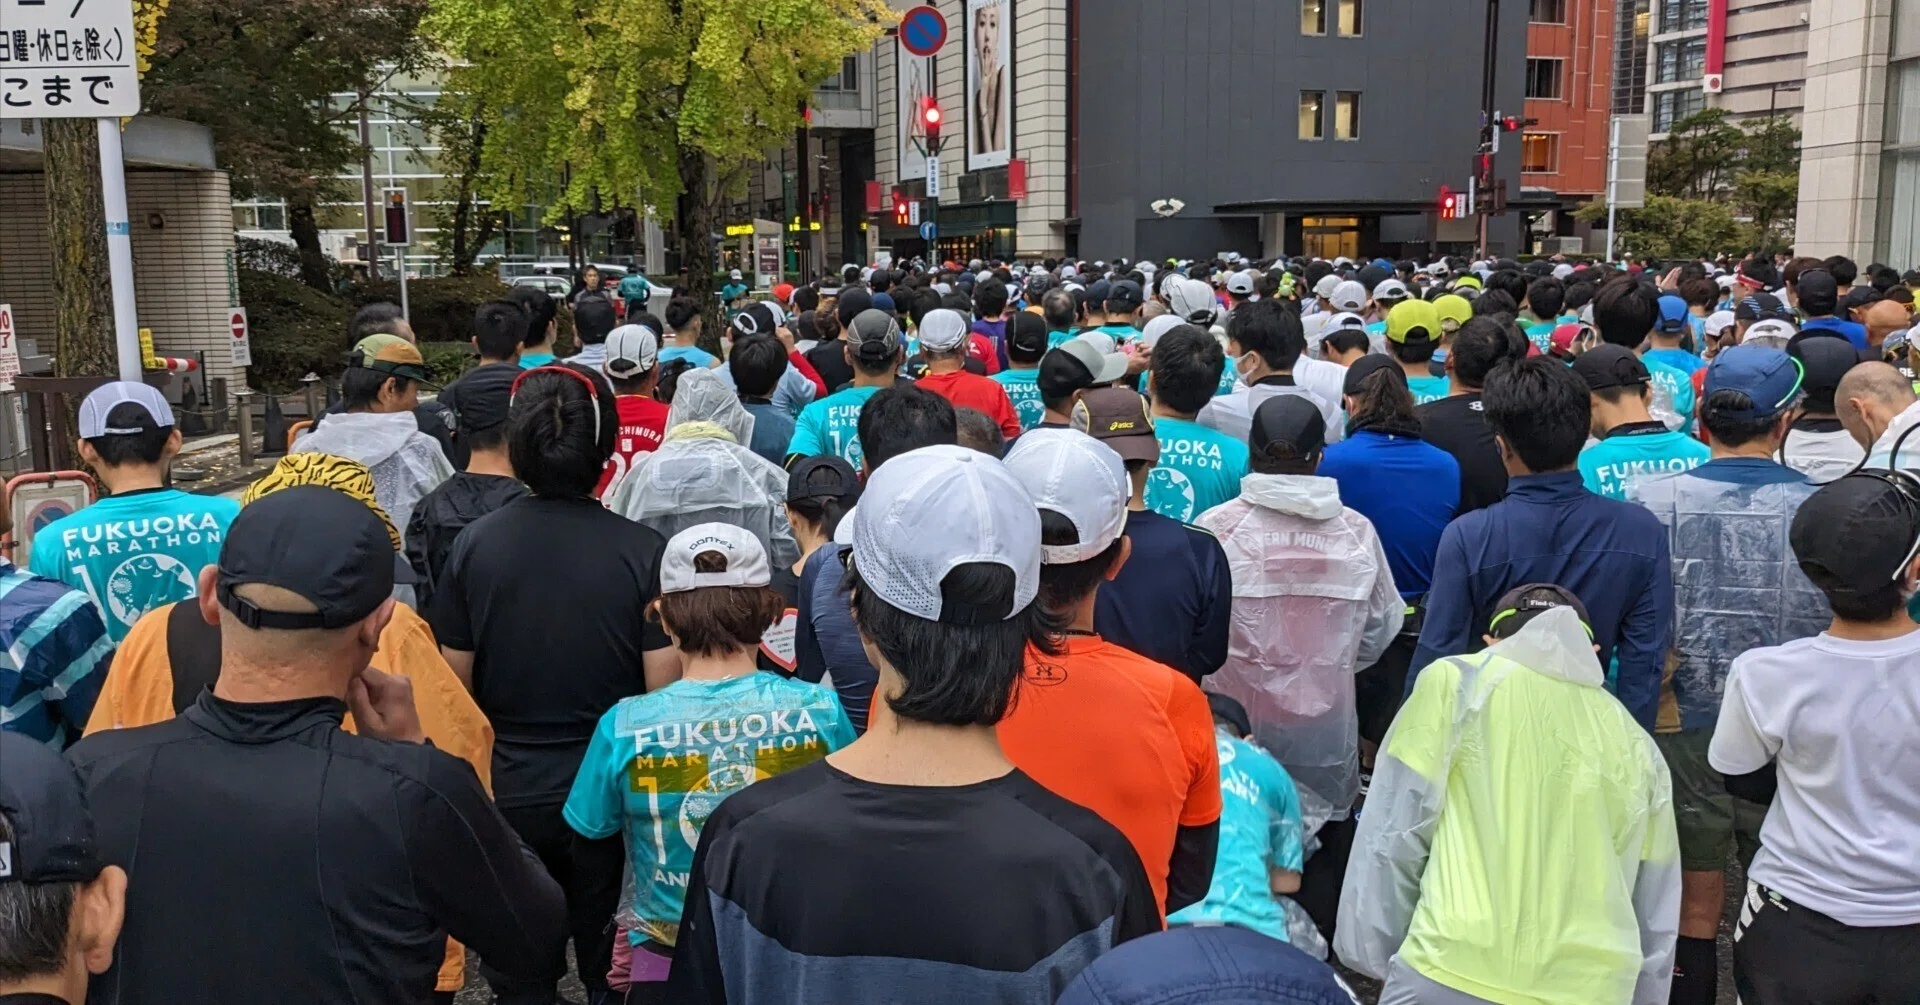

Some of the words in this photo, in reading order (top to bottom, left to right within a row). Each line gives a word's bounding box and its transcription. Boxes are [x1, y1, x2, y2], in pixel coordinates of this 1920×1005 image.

[4, 75, 114, 107] こまで
[1117, 421, 1134, 429] asics
[62, 512, 219, 548] FUKUOKA
[66, 530, 221, 562] MARATHON
[634, 709, 817, 754] FUKUOKA
[636, 734, 818, 770] MARATHON
